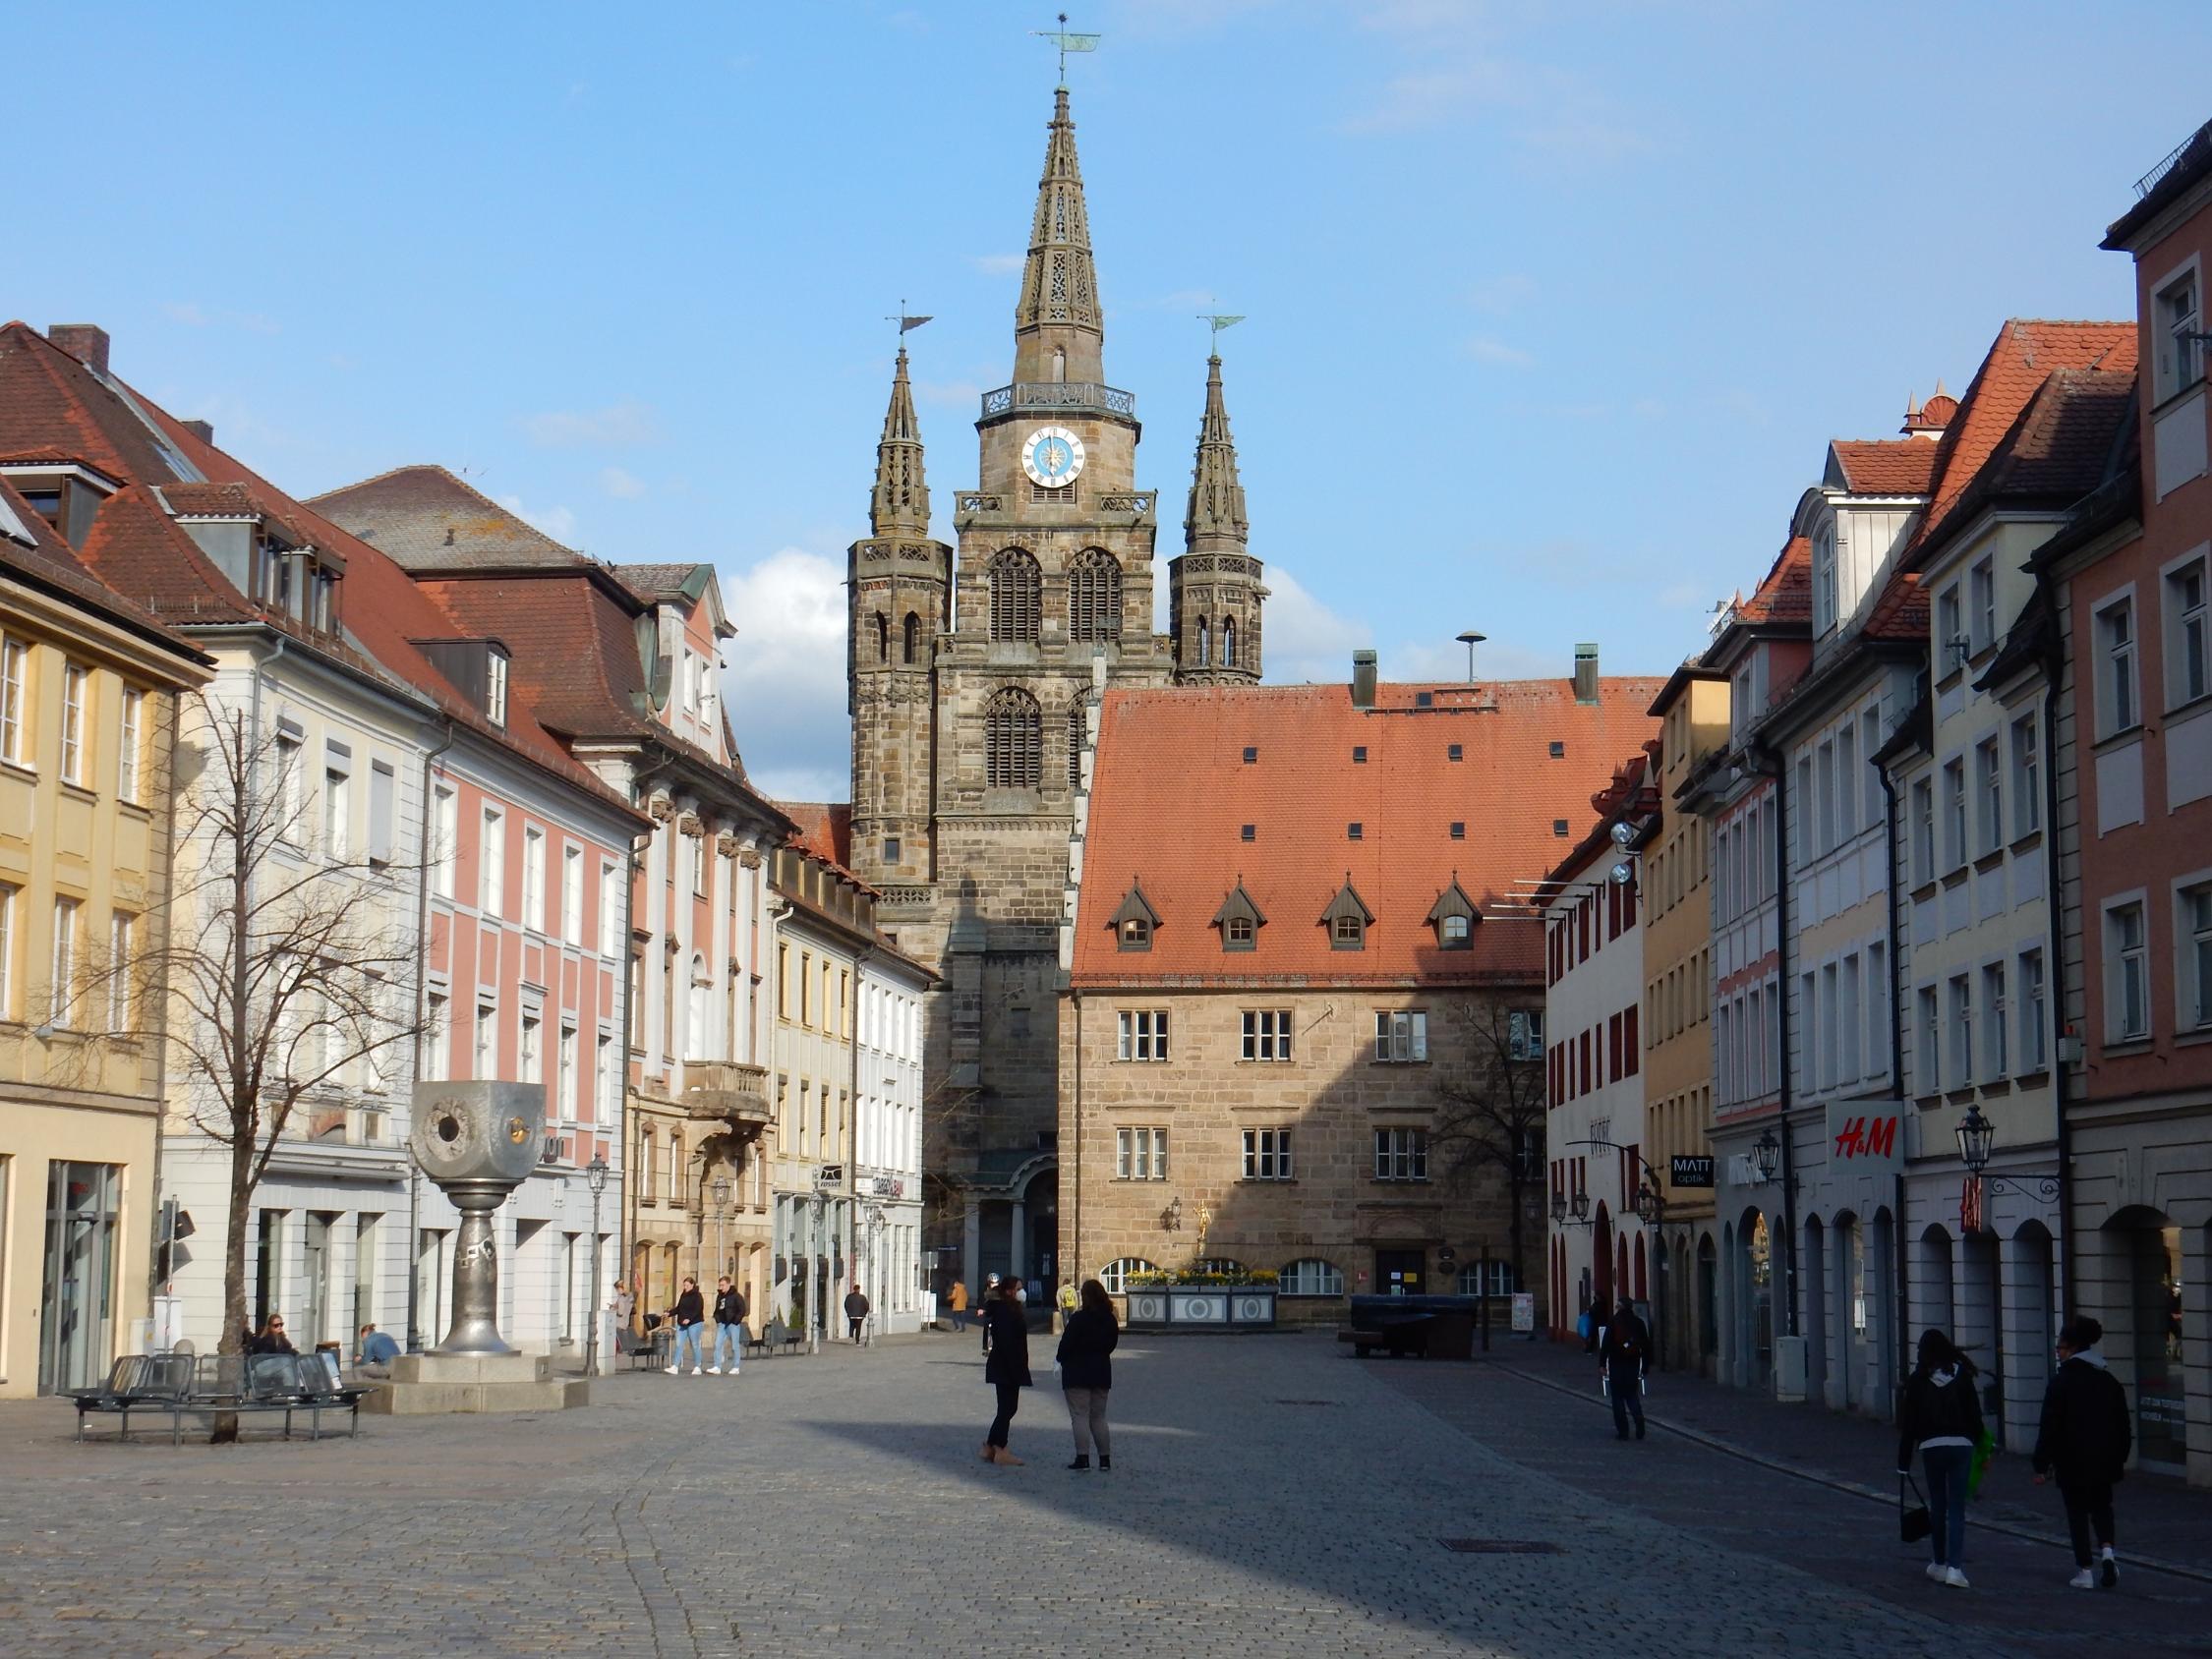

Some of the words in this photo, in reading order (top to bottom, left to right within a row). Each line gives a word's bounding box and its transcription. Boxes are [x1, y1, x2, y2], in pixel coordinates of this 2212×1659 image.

[1834, 1116, 1897, 1159] H&M
[1673, 1159, 1711, 1173] MATT
[1677, 1173, 1706, 1184] optik
